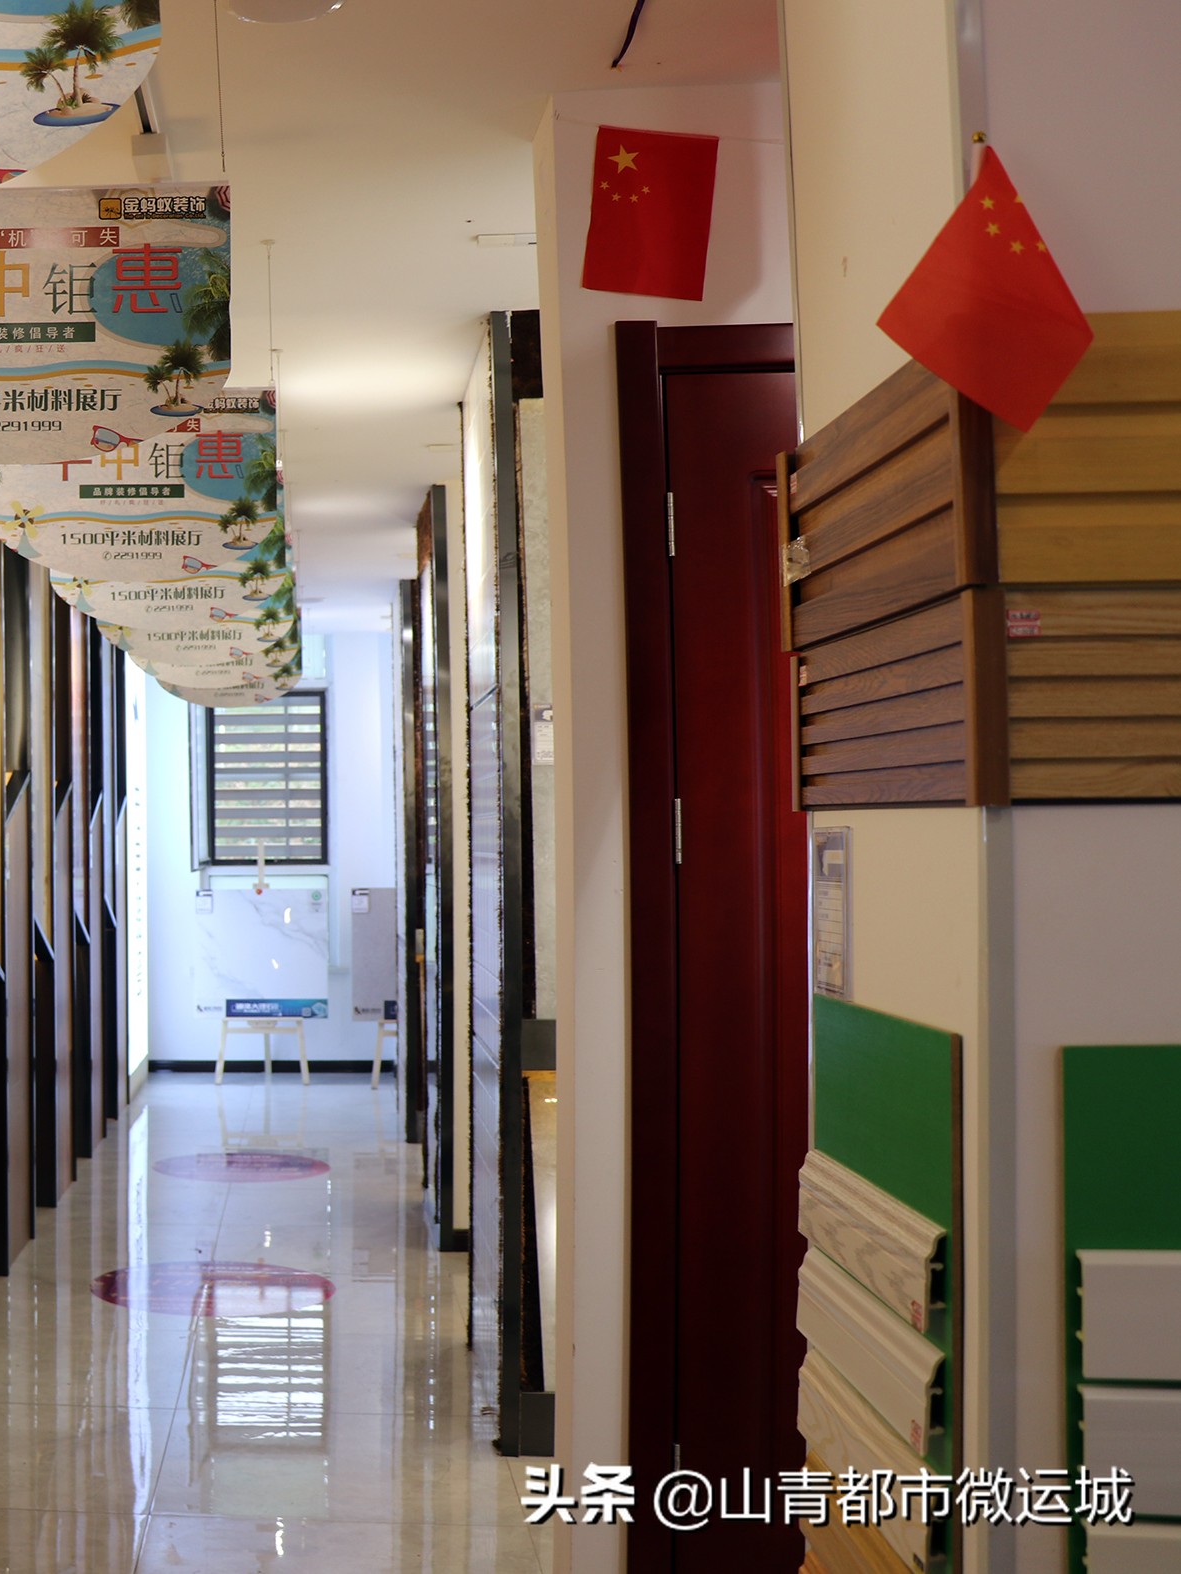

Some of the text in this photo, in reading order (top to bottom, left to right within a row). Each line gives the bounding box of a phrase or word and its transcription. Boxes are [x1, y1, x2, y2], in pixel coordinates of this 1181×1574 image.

[124, 197, 206, 213] 金蚂蚁装饰
[61, 530, 203, 546] 1500平米材料展厅
[110, 585, 227, 601] 1500平米材料展厅
